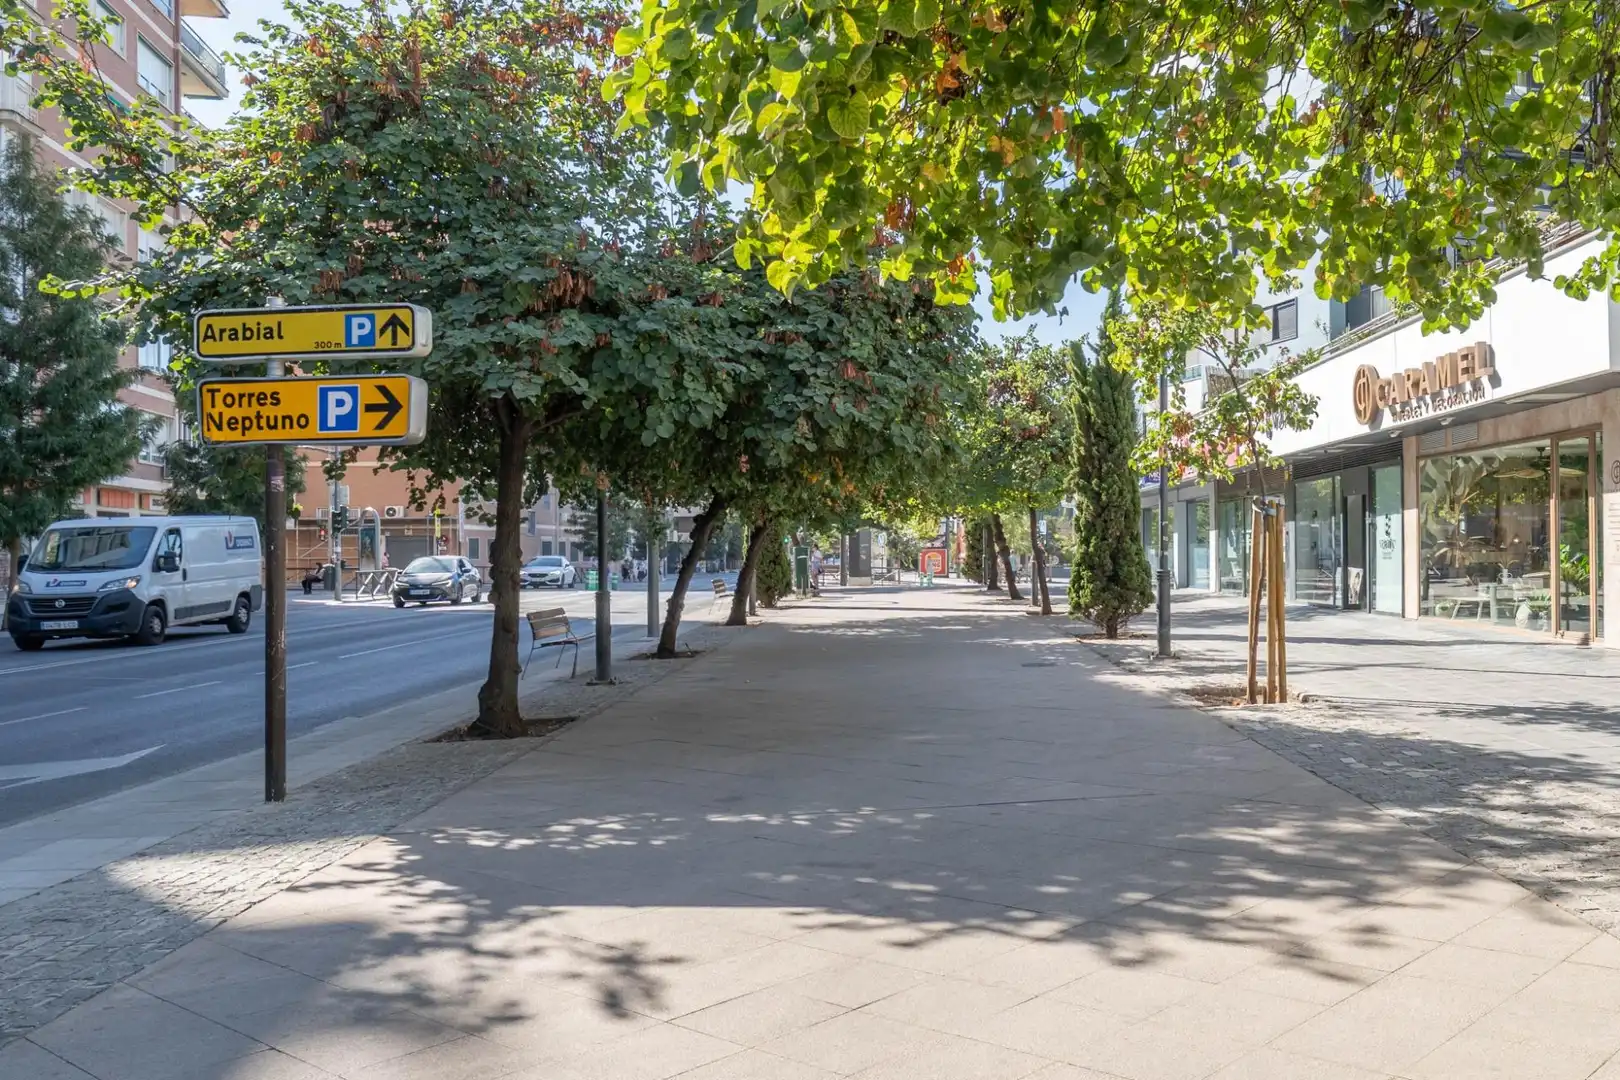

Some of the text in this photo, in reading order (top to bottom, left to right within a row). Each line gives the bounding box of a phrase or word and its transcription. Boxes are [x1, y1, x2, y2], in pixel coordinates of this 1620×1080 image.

[202, 321, 284, 342] Arabial
[351, 317, 372, 345] P
[314, 341, 332, 350] 300
[1376, 341, 1494, 409] CARAMEL
[206, 388, 281, 409] Torres
[327, 390, 353, 428] P
[206, 410, 310, 437] Neptuno
